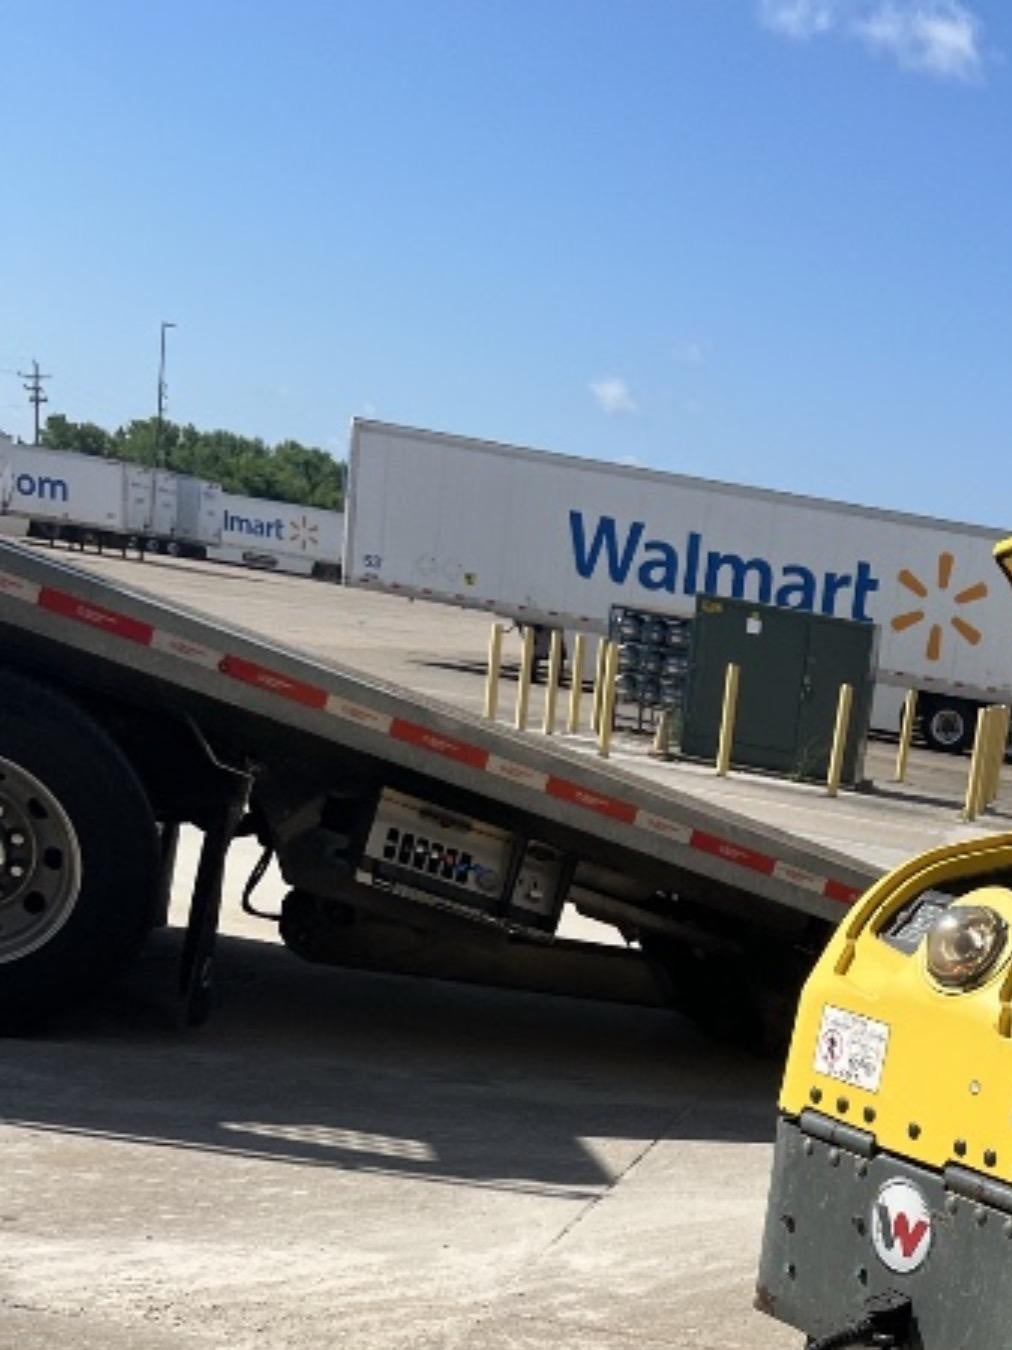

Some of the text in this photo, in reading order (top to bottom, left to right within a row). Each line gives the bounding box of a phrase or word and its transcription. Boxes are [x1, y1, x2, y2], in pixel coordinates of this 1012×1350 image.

[12, 472, 69, 502] om
[224, 509, 284, 541] lmart
[569, 510, 879, 622] Walmart
